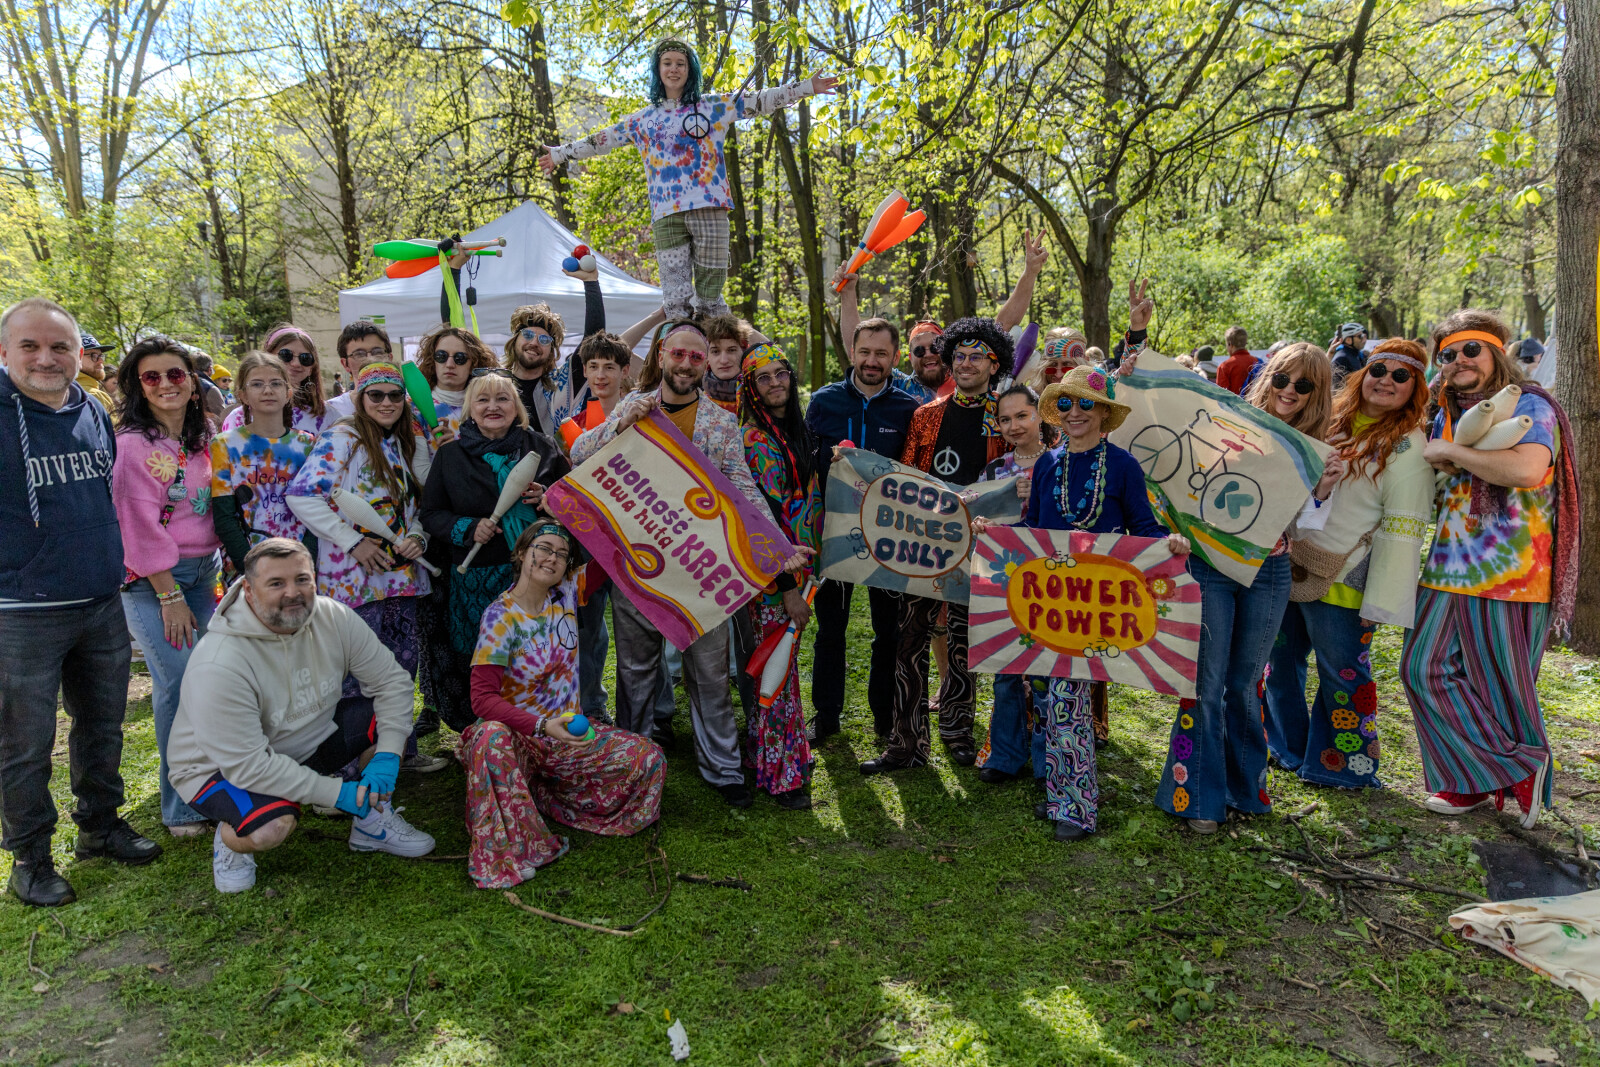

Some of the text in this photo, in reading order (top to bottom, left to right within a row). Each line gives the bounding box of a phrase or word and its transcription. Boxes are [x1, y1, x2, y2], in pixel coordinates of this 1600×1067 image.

[880, 477, 960, 515] GOOD
[607, 453, 752, 614] wolność KRĘCI
[875, 504, 963, 543] BIKES
[874, 537, 954, 570] ONLY
[1021, 570, 1143, 608] ROWER
[1028, 602, 1144, 643] POWER
